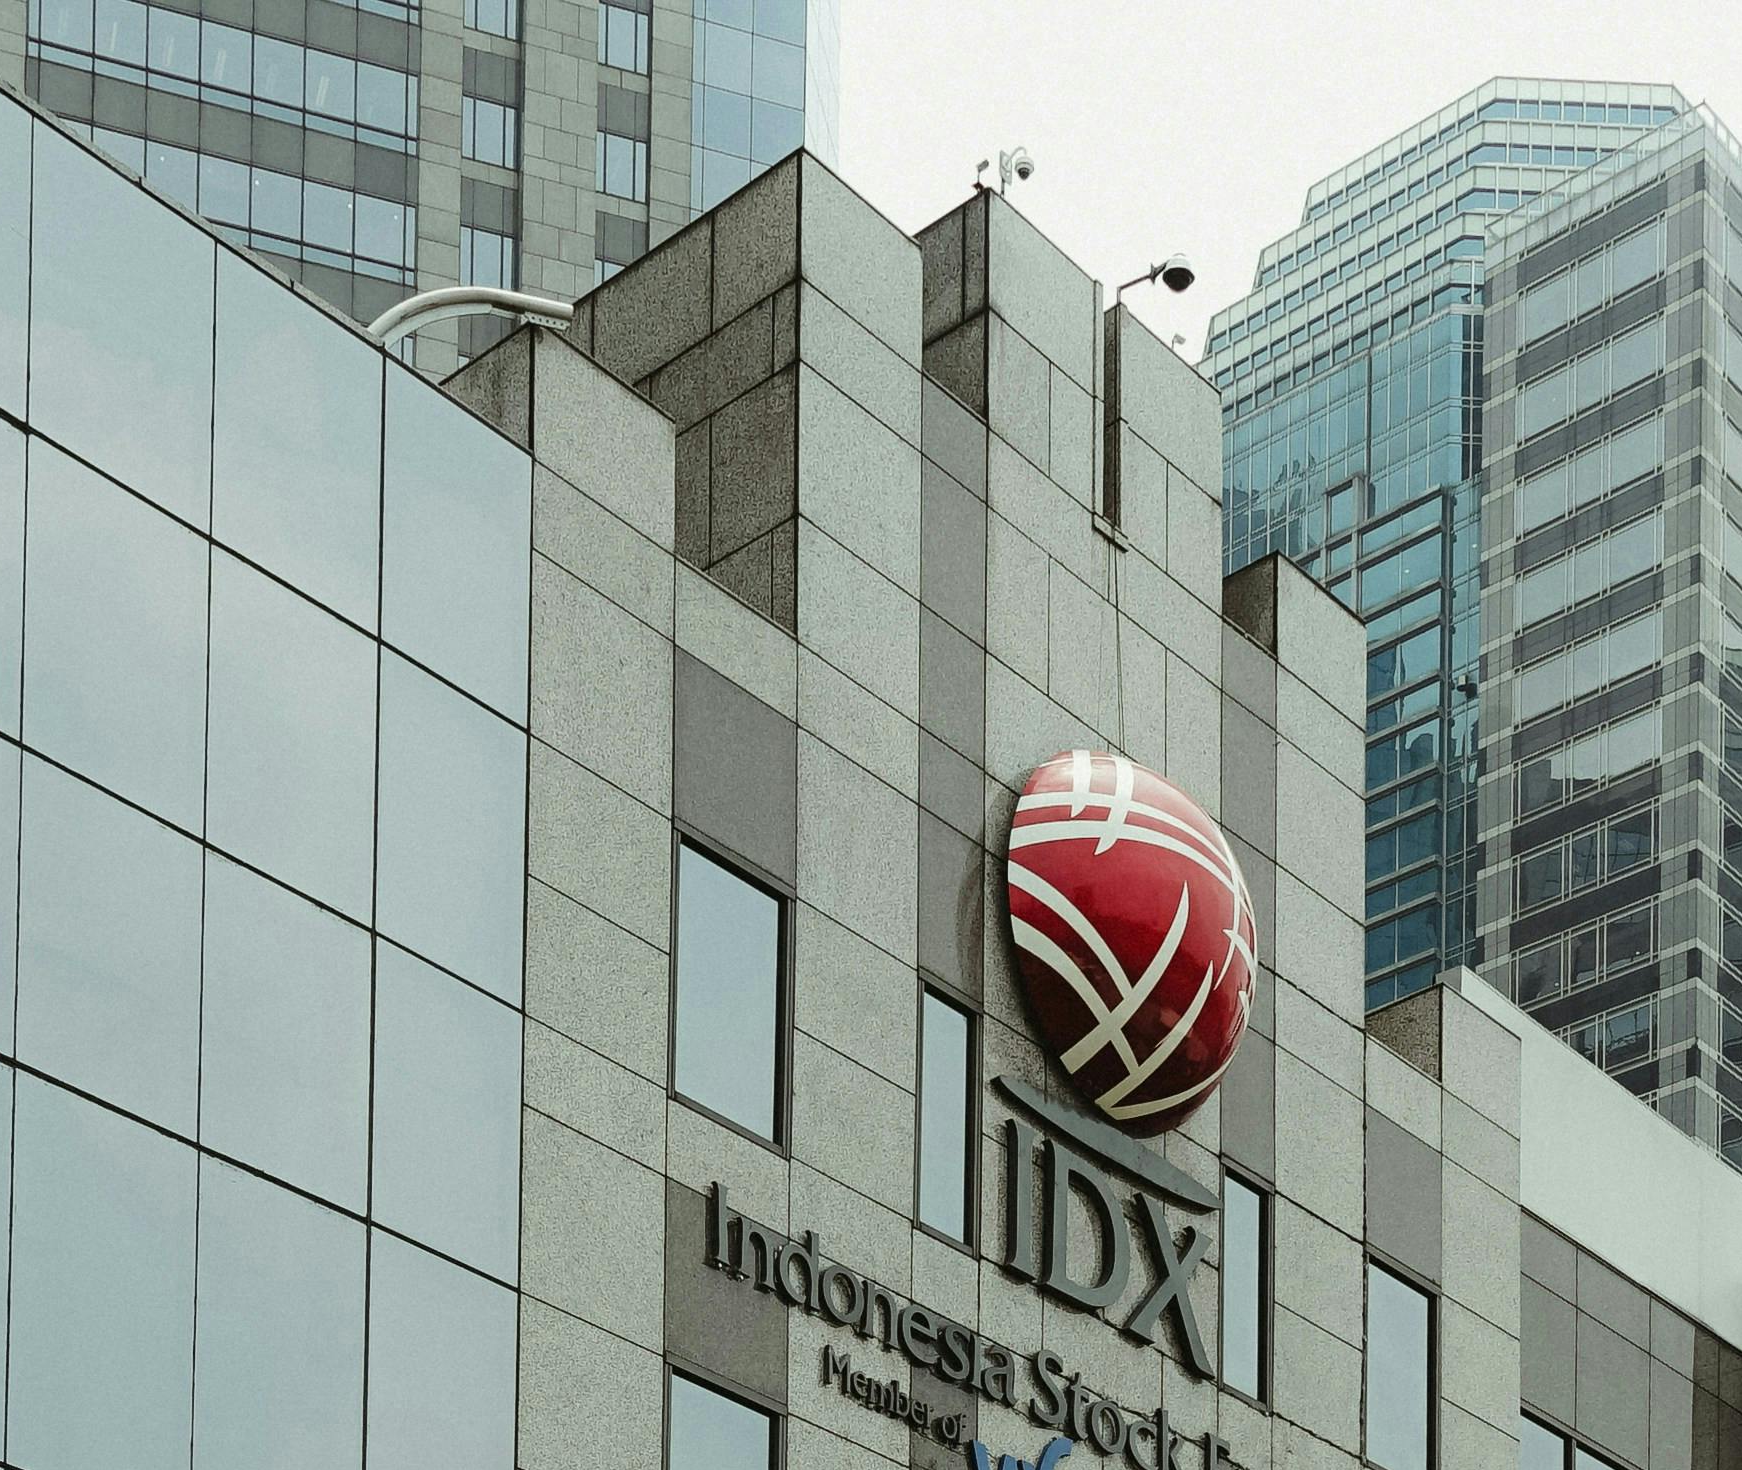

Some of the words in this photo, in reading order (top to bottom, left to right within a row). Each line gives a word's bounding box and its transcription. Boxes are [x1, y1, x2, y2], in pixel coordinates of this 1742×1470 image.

[706, 1181, 1018, 1407] Indonesia
[1003, 1116, 1215, 1381] IDX
[821, 1344, 934, 1430] Member
[940, 1411, 967, 1440] of
